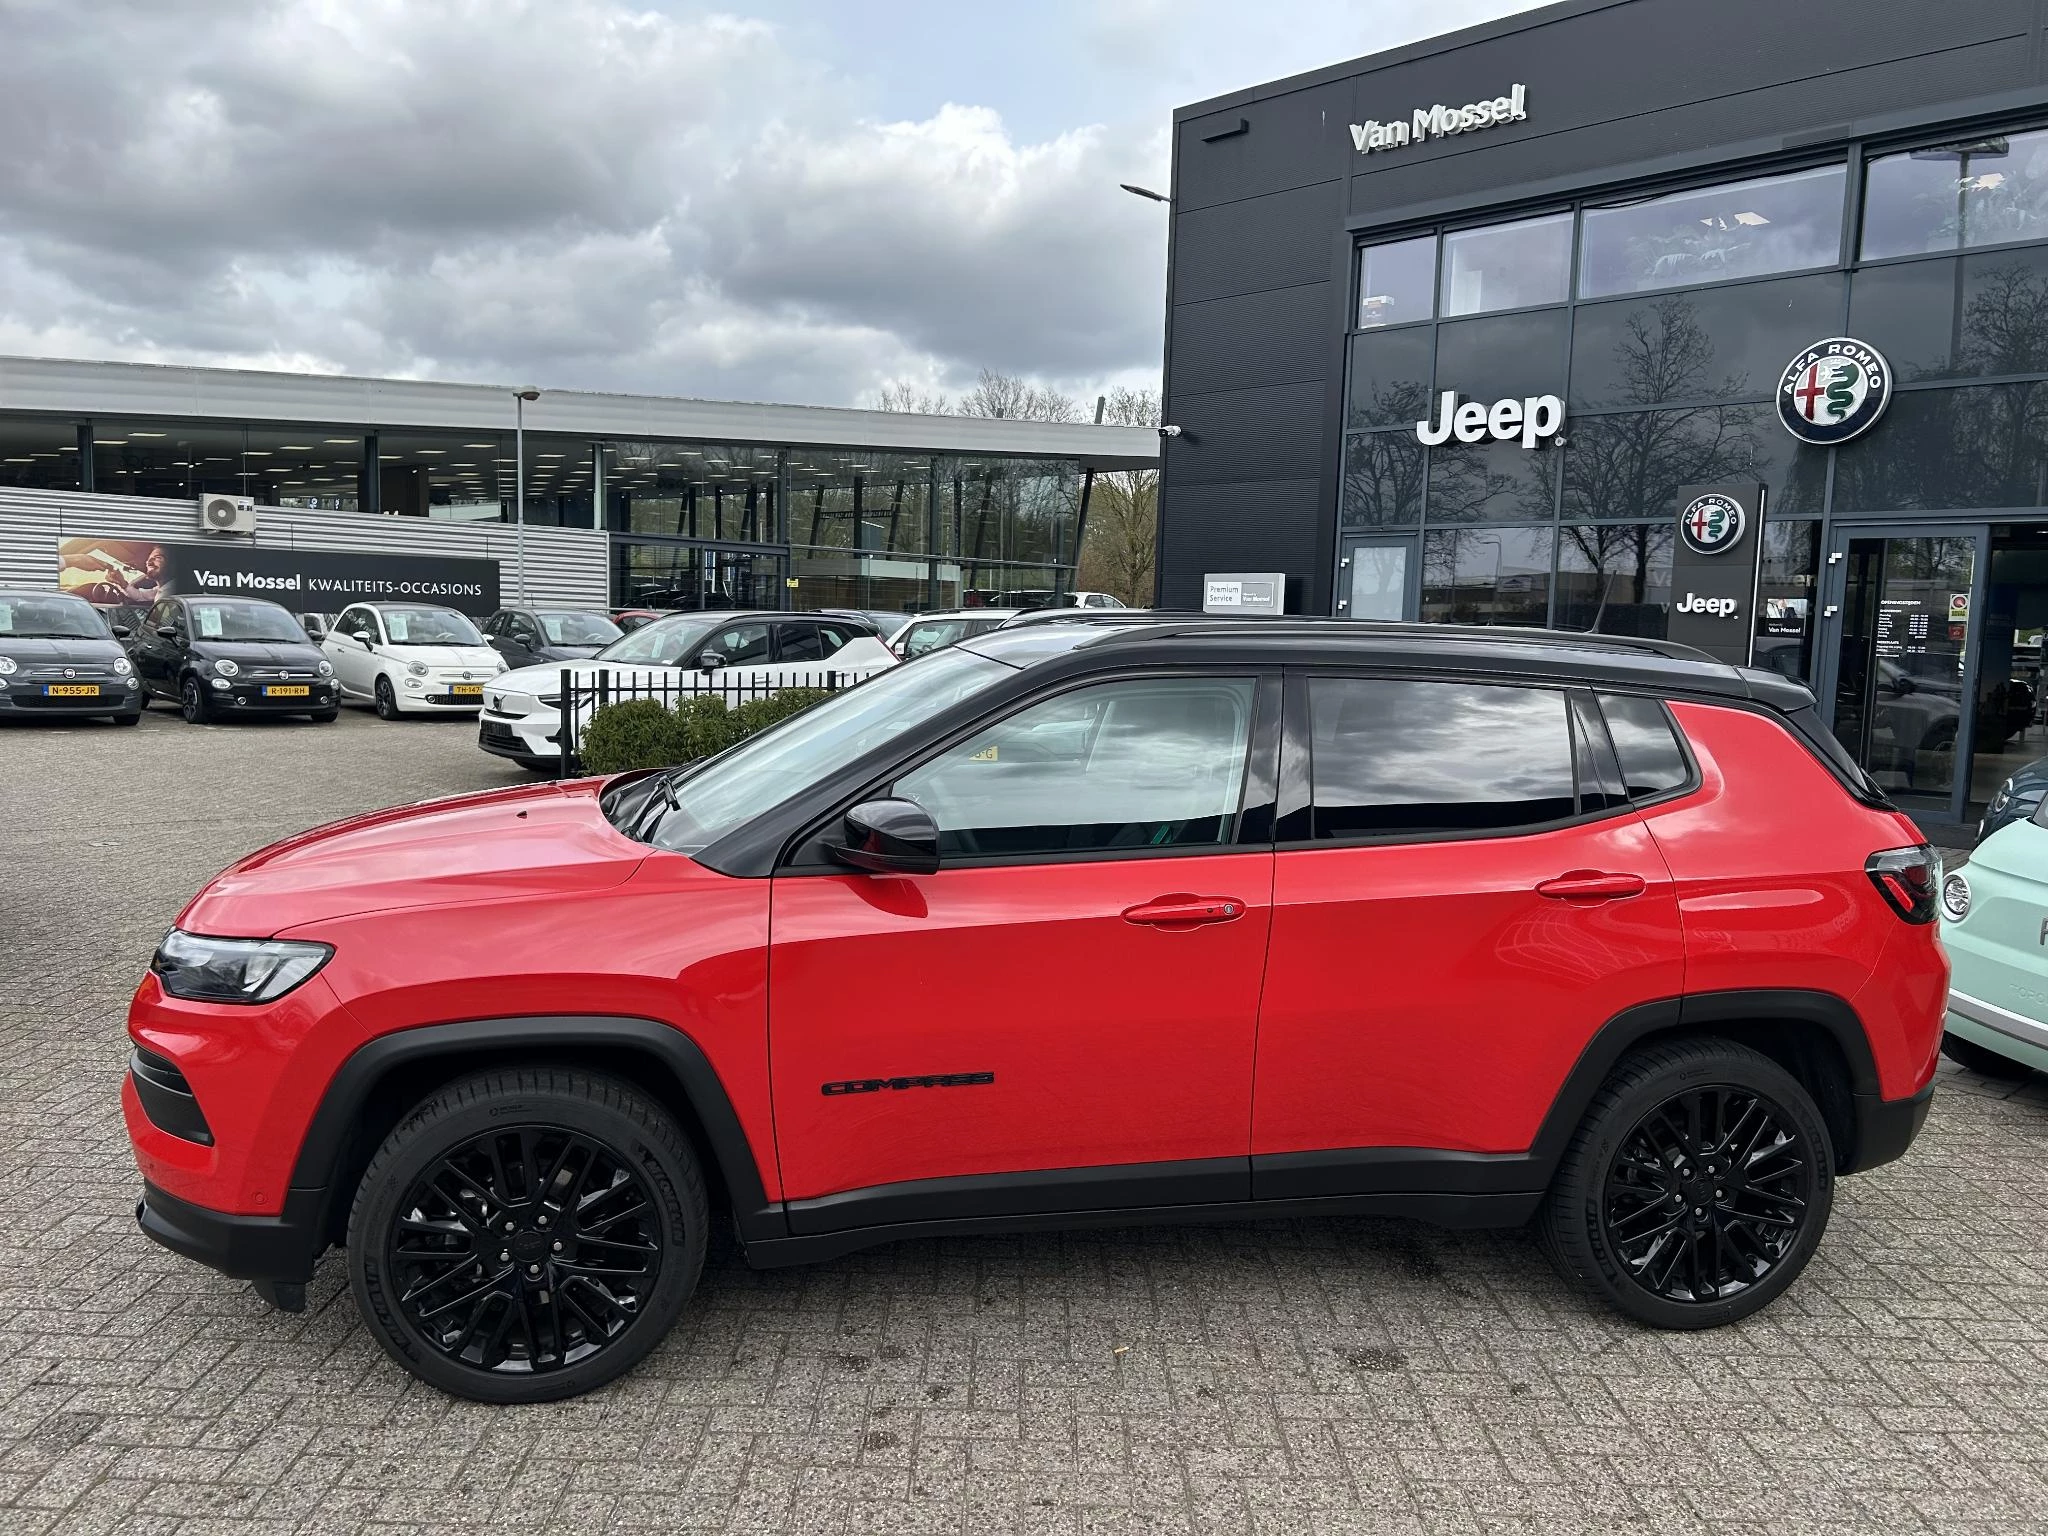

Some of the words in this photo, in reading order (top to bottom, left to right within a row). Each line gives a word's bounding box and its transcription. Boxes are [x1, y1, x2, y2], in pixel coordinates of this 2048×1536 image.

[1349, 119, 1410, 155] Van
[1412, 82, 1527, 143] Mossel
[1783, 351, 1820, 395] ALFA
[1827, 343, 1882, 389] ROMEO
[1416, 390, 1563, 449] Jeep
[1685, 502, 1705, 525] ALFA
[1708, 498, 1738, 525] ROMEO
[193, 569, 232, 588] Van
[236, 571, 301, 591] Mossel
[308, 578, 482, 596] KWALITEITS-OCCASIONS
[1209, 585, 1239, 594] Premium
[1209, 594, 1233, 602] Service
[1676, 592, 1737, 618] Jeep
[52, 686, 96, 695] N-955-JR
[821, 1071, 995, 1096] COMPASS
